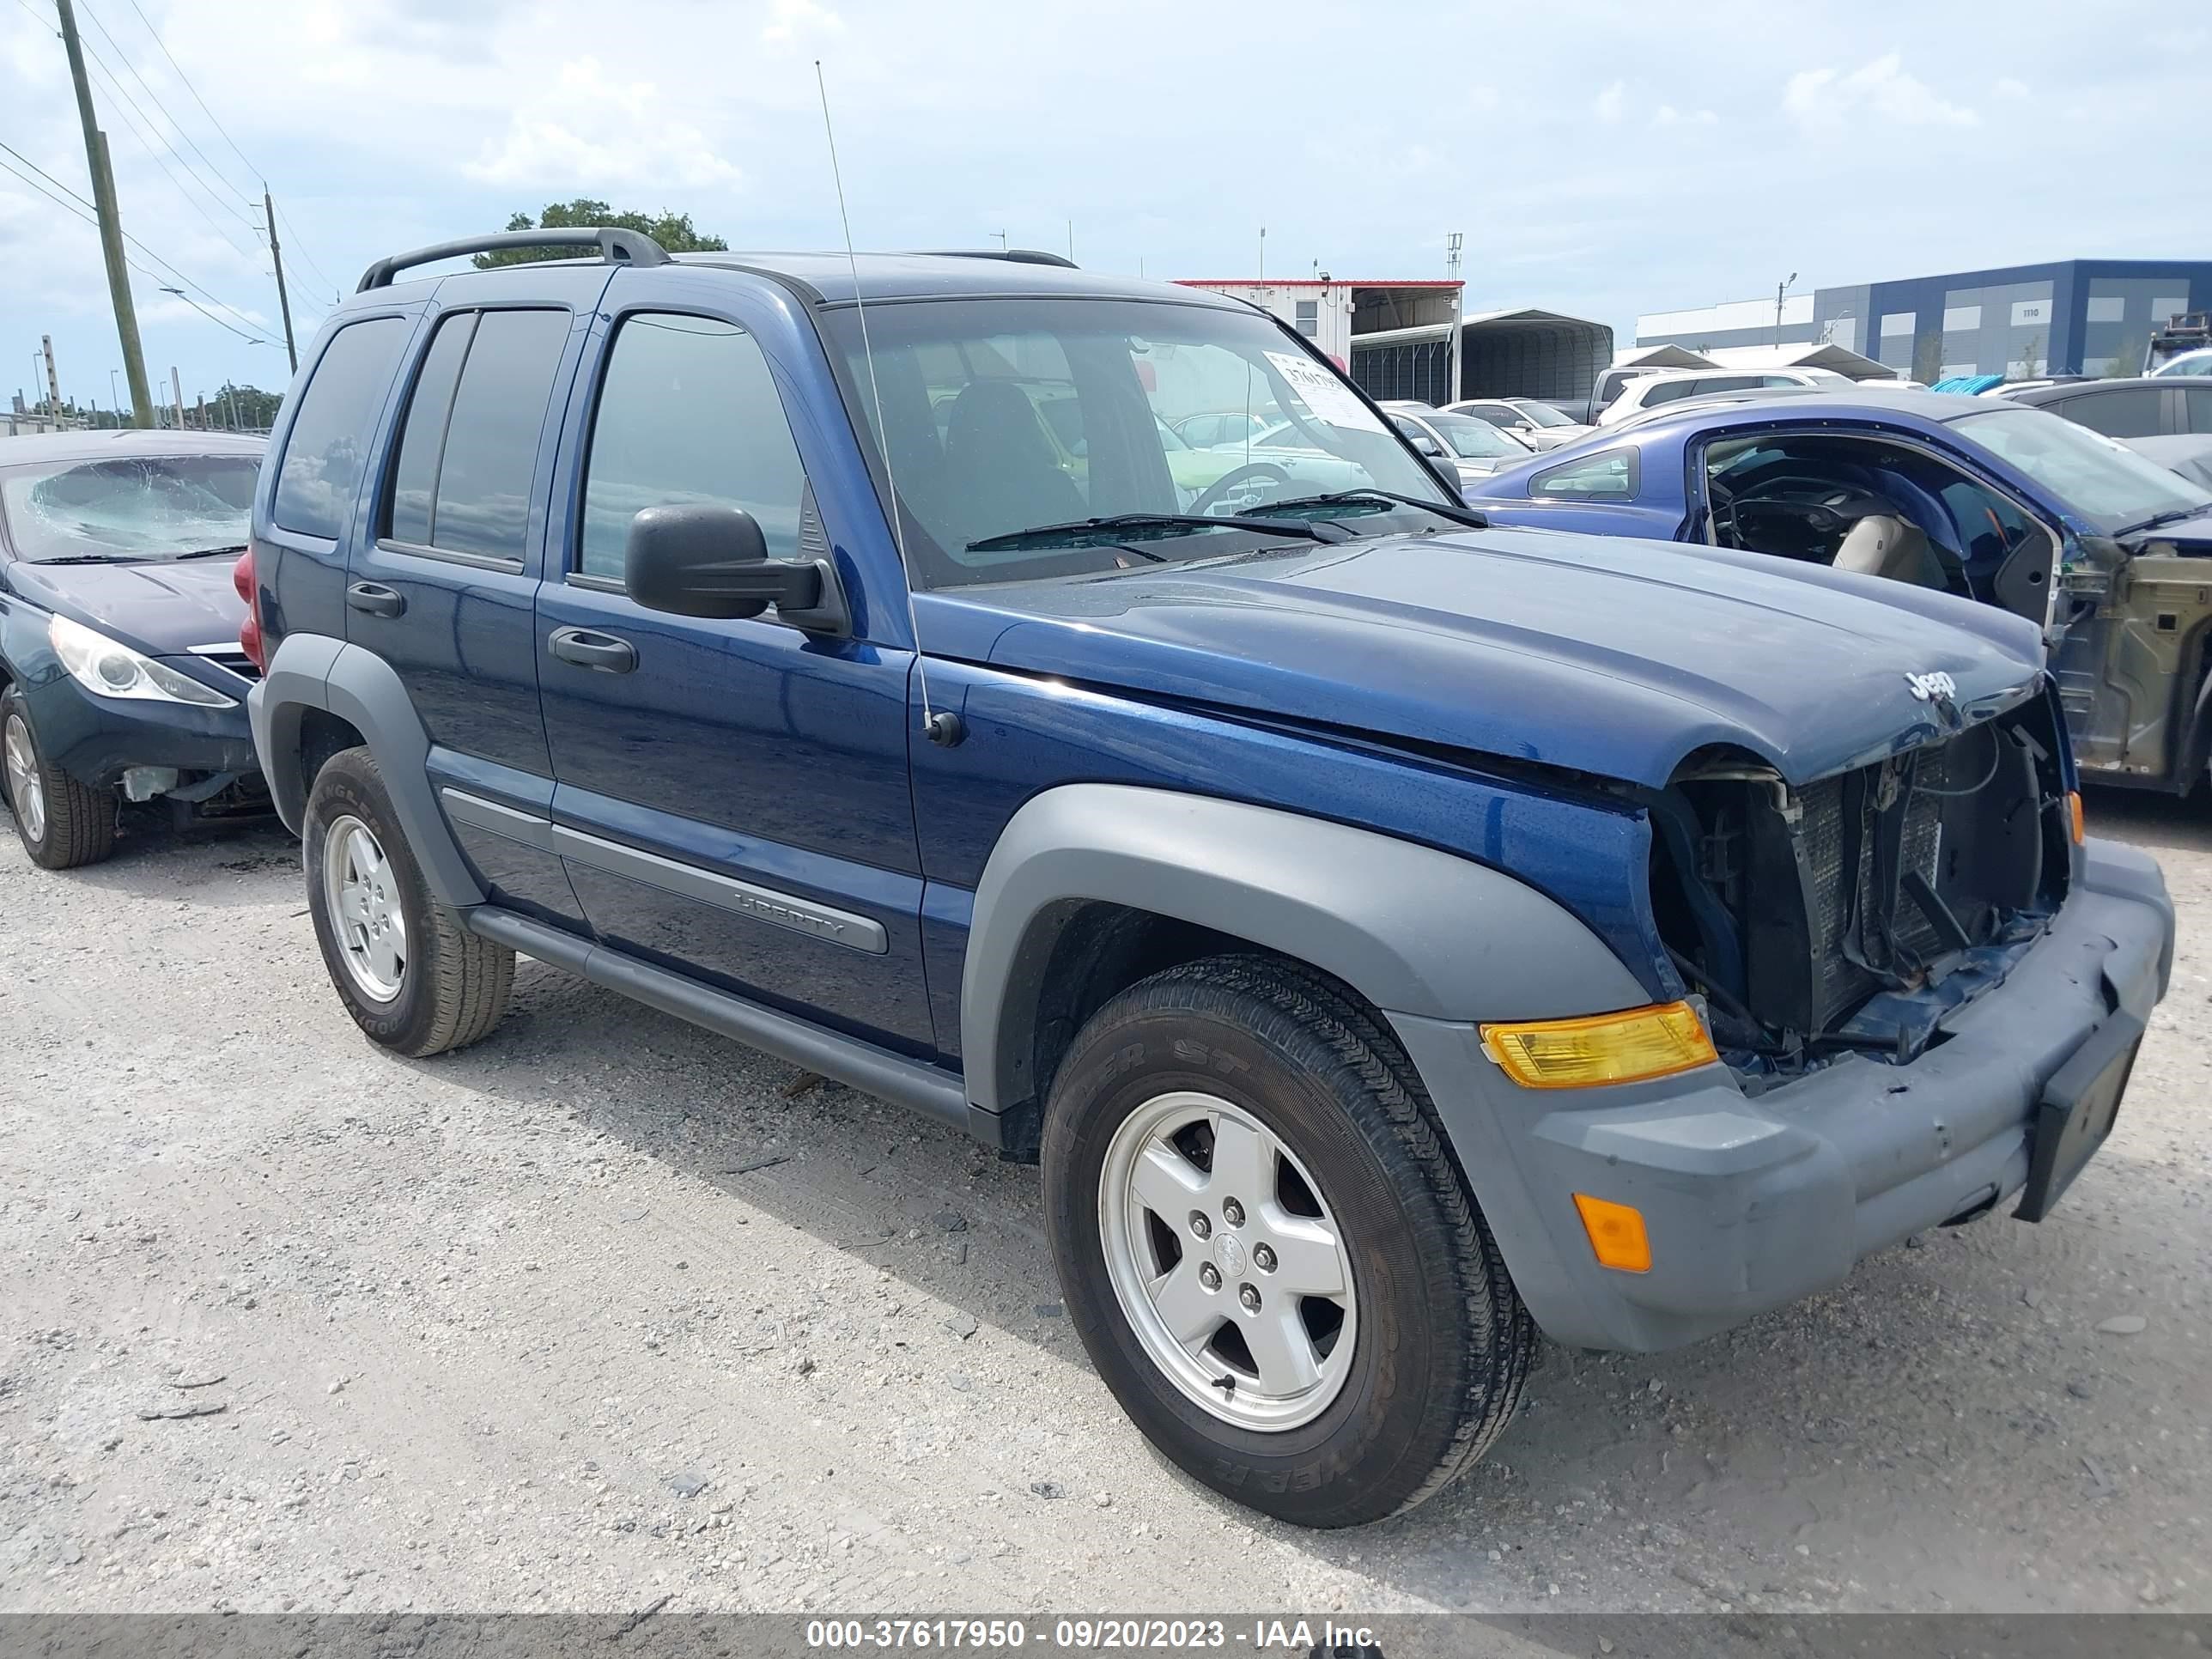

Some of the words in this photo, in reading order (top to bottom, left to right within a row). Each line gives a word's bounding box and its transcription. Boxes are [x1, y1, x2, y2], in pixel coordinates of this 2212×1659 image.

[2023, 308, 2039, 318] 1110
[1903, 671, 1957, 702] Jeep
[734, 893, 846, 934] LIBERTY
